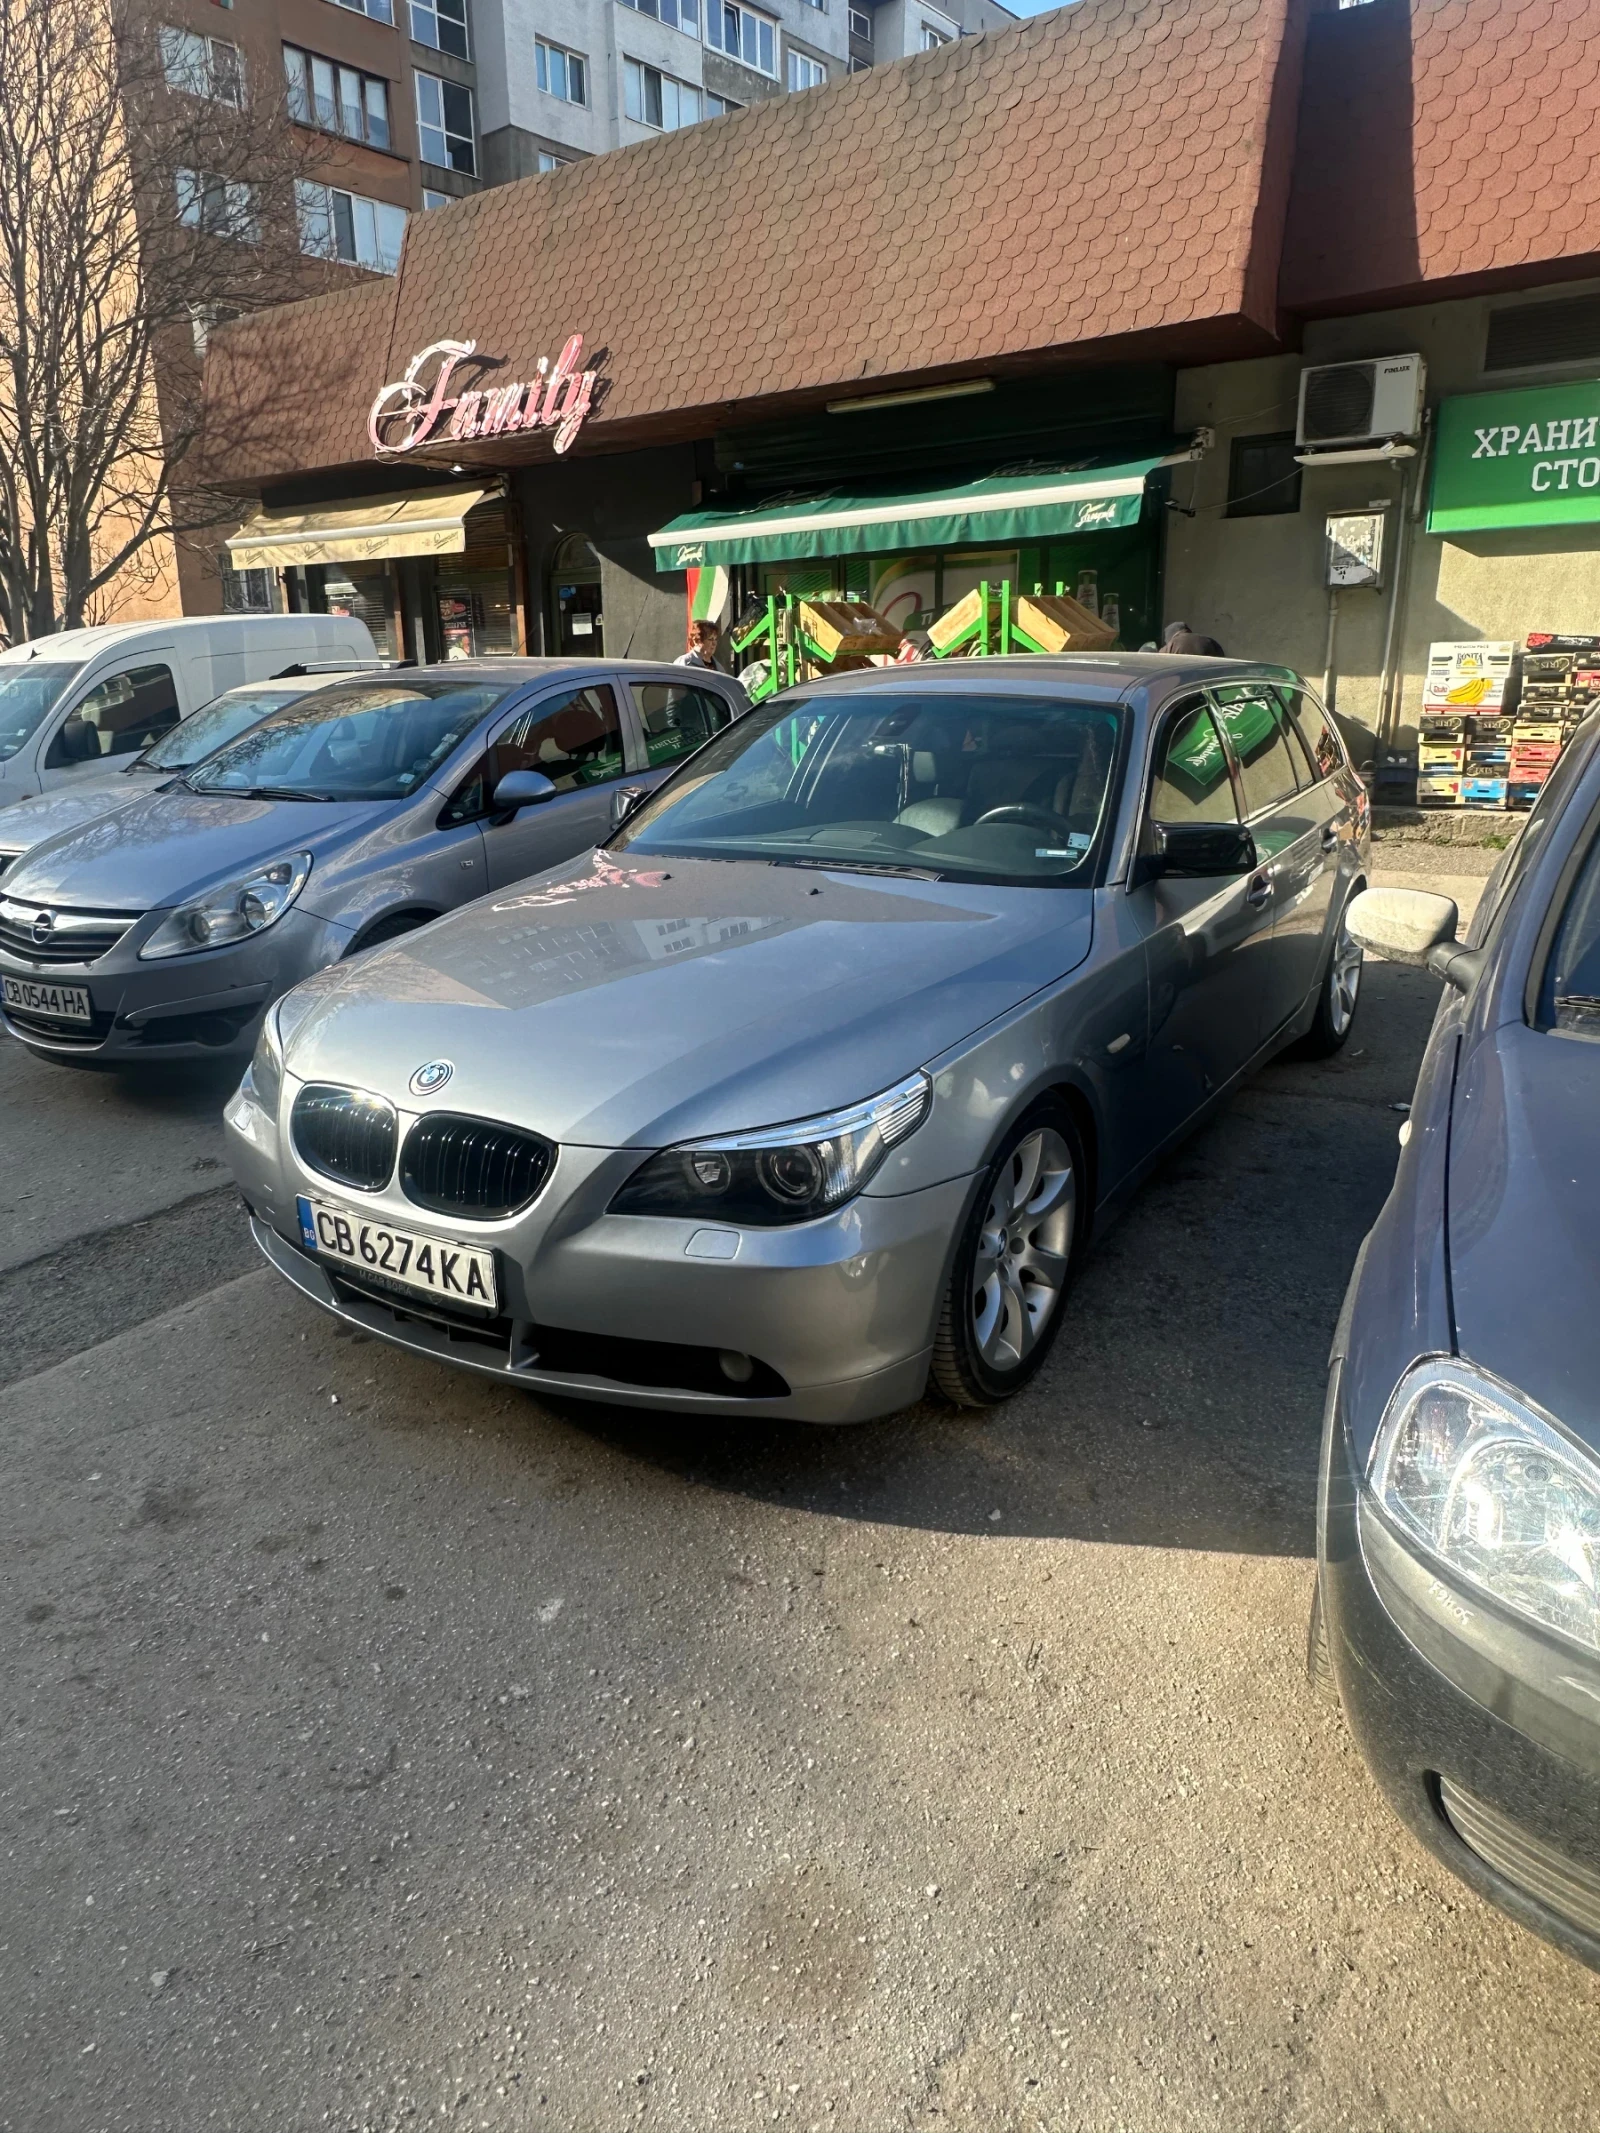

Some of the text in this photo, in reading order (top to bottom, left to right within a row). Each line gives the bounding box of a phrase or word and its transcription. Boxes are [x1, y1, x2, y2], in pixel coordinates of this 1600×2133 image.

[368, 334, 598, 455] Family
[1531, 457, 1600, 492] СТО
[1456, 652, 1484, 666] BONITA
